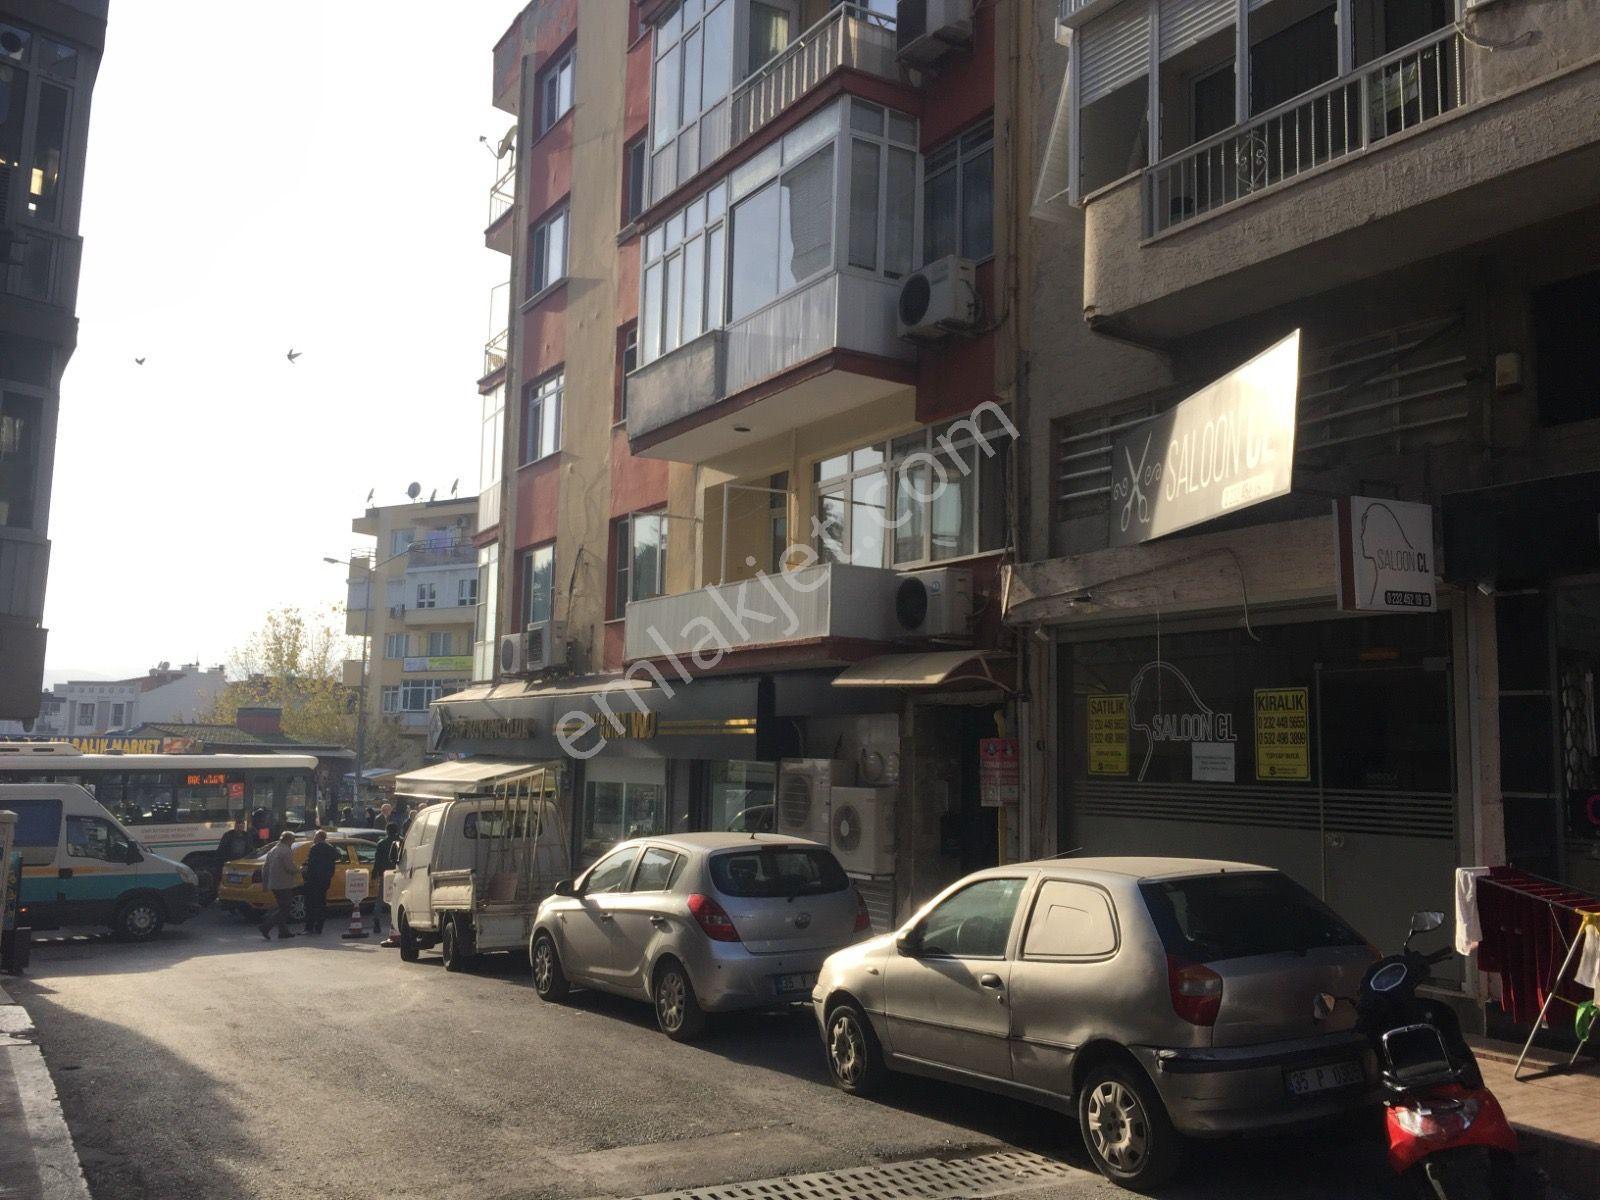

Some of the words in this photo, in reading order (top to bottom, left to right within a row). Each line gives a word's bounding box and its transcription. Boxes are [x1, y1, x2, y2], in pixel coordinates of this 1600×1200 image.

[1166, 408, 1241, 502] SALOON
[1376, 548, 1415, 572] SALOON
[1417, 552, 1430, 573] CL
[1090, 699, 1125, 715] SATILIK
[1257, 694, 1304, 711] KIRALIK
[1152, 713, 1214, 742] SALOON
[1215, 713, 1238, 742] CL
[1264, 716, 1276, 729] 232
[73, 738, 108, 754] BALIK
[112, 737, 161, 754] MARKET
[1264, 732, 1276, 745] 532
